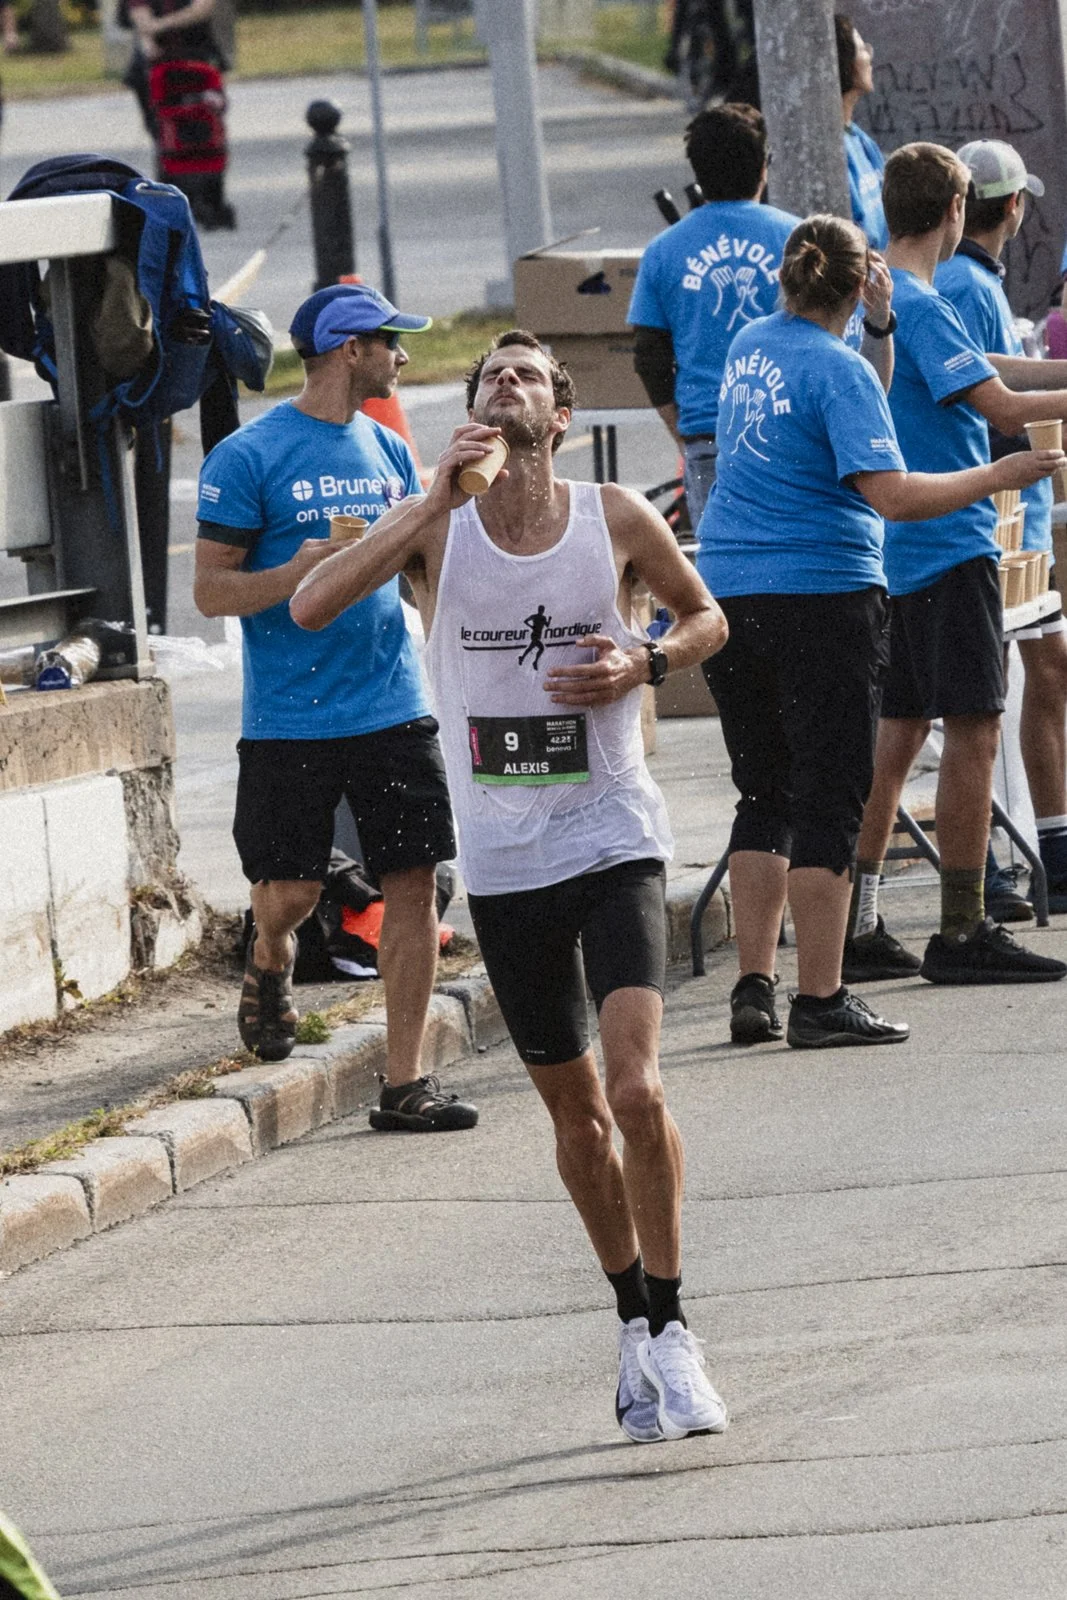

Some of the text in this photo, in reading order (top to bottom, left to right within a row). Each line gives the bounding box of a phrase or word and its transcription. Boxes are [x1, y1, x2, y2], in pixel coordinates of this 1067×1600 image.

[682, 233, 782, 291] BÉNÉVOLE
[720, 348, 792, 416] BÉNÉVOLE
[319, 475, 386, 497] Brune
[296, 508, 319, 523] on
[322, 506, 340, 519] se
[461, 623, 602, 641] le coureur nordique
[504, 731, 519, 751] 9
[503, 762, 550, 774] ALEXIS
